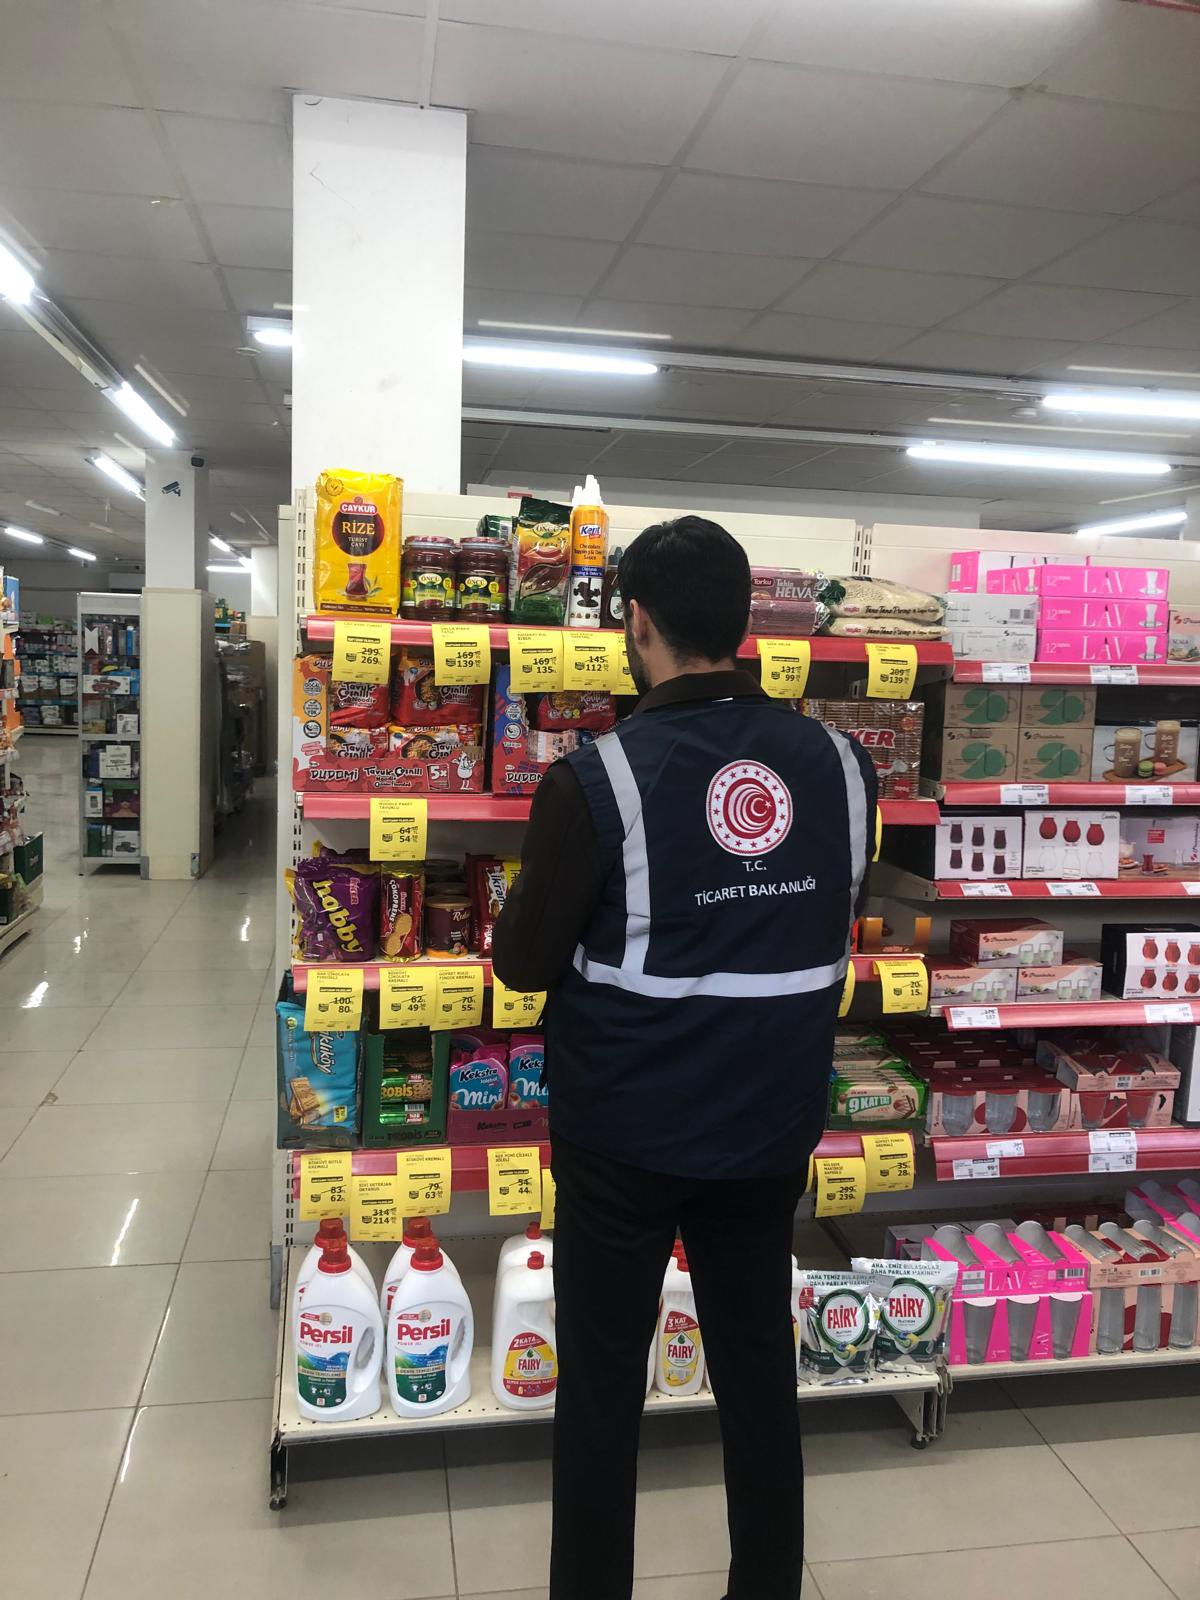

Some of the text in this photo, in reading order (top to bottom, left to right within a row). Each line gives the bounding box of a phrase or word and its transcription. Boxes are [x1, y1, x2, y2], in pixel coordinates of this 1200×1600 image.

[342, 520, 375, 535] RİZE
[580, 526, 600, 535] Kent
[1084, 569, 1128, 594] LAV
[775, 586, 813, 599] HELVA
[1082, 603, 1128, 628] LAV
[1082, 635, 1127, 660] LAV
[360, 656, 379, 665] 269
[457, 651, 474, 659] 169
[457, 660, 474, 668] 139
[536, 666, 553, 674] 135
[586, 664, 602, 672] 112
[785, 674, 795, 682] 99
[889, 676, 903, 684] 139
[742, 860, 767, 872] T.C.
[694, 874, 816, 906] TİCARET BAKANLIĞI
[312, 880, 363, 953] hobby
[462, 996, 473, 1004] 70
[408, 1004, 419, 1012] 49
[462, 1004, 472, 1012] 55
[456, 1088, 503, 1106] Mini
[848, 1098, 859, 1112] 9
[860, 1097, 879, 1109] KAT
[330, 1186, 342, 1194] 83
[988, 1270, 1027, 1292] LAV
[668, 1318, 674, 1328] 3
[300, 1322, 353, 1344] Persil
[397, 1318, 451, 1342] Persil
[513, 1339, 520, 1348] 2
[668, 1344, 694, 1359] FAIRY
[518, 1358, 541, 1370] FAIRY
